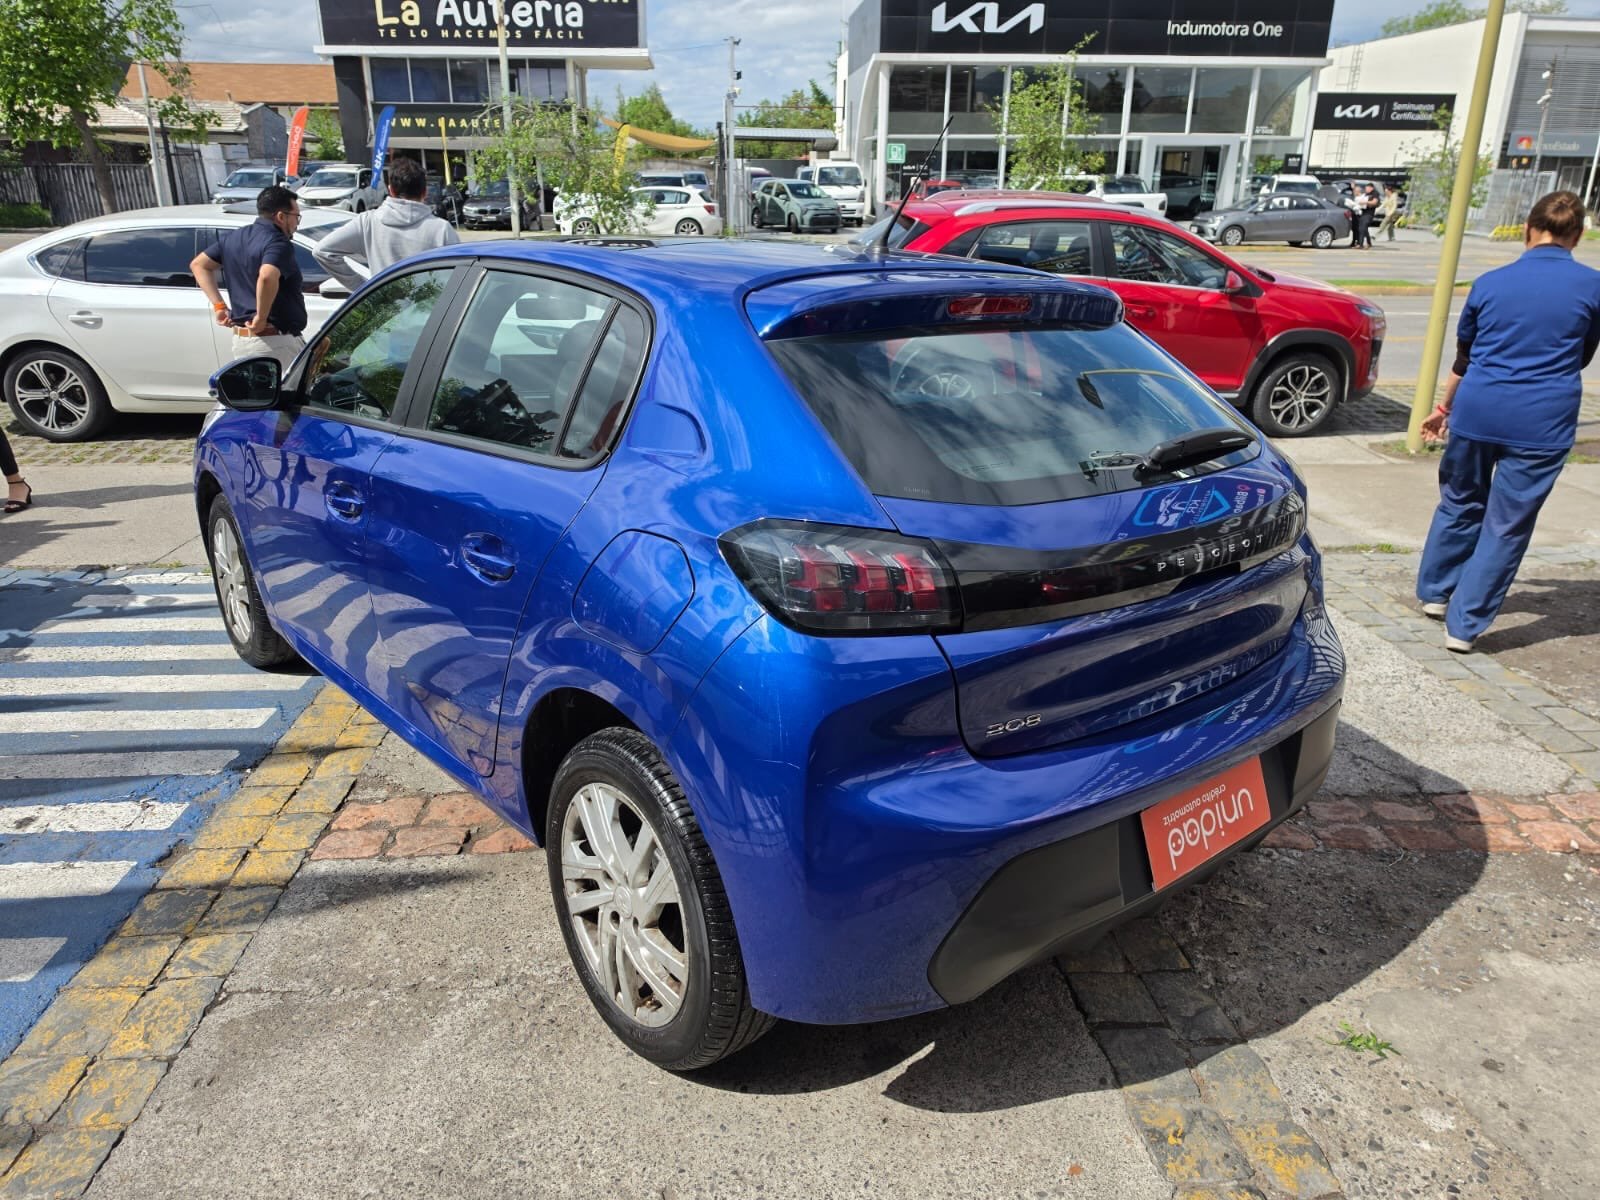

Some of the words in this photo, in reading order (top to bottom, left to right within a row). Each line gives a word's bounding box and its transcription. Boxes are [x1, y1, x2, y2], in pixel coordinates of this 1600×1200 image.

[374, 0, 421, 27] La
[378, 28, 398, 38] TE
[410, 28, 429, 39] LO
[534, 28, 585, 40] FÁCIL
[1166, 19, 1250, 37] Indumotora
[1252, 21, 1284, 38] One
[1392, 101, 1436, 112] Seminuevos
[1157, 534, 1264, 573] PEUGEOT
[985, 713, 1042, 738] 208
[1201, 783, 1227, 805] crédito
[1162, 797, 1202, 827] automotriz
[1167, 788, 1255, 872] unidad
